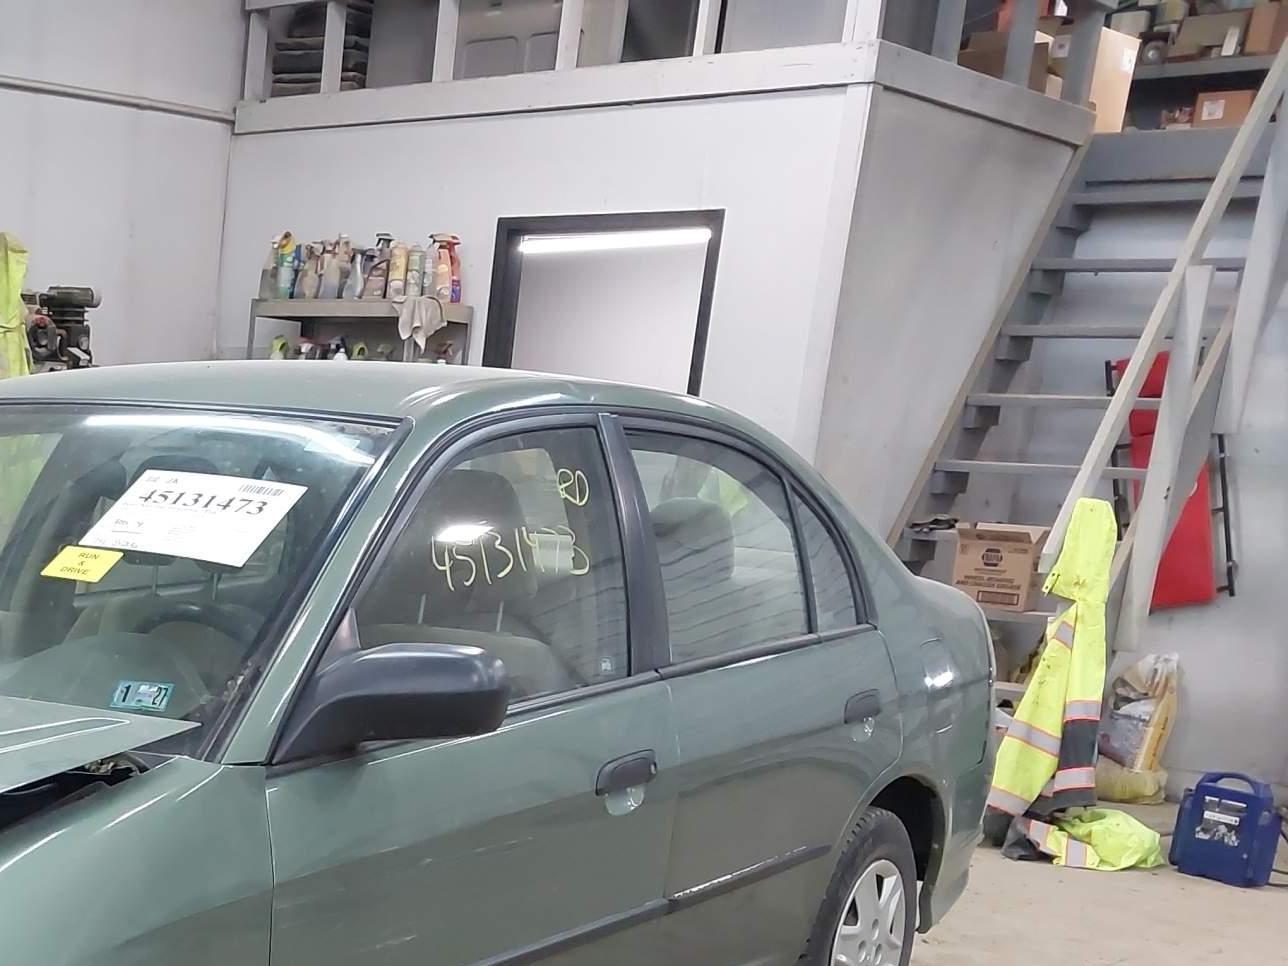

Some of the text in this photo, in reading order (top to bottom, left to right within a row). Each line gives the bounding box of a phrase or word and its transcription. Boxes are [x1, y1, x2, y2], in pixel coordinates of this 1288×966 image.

[139, 489, 268, 516] 45131473
[78, 552, 101, 560] RUN
[431, 525, 590, 592] 45131473
[60, 566, 90, 575] DRIVE
[122, 684, 168, 706] 1 27
